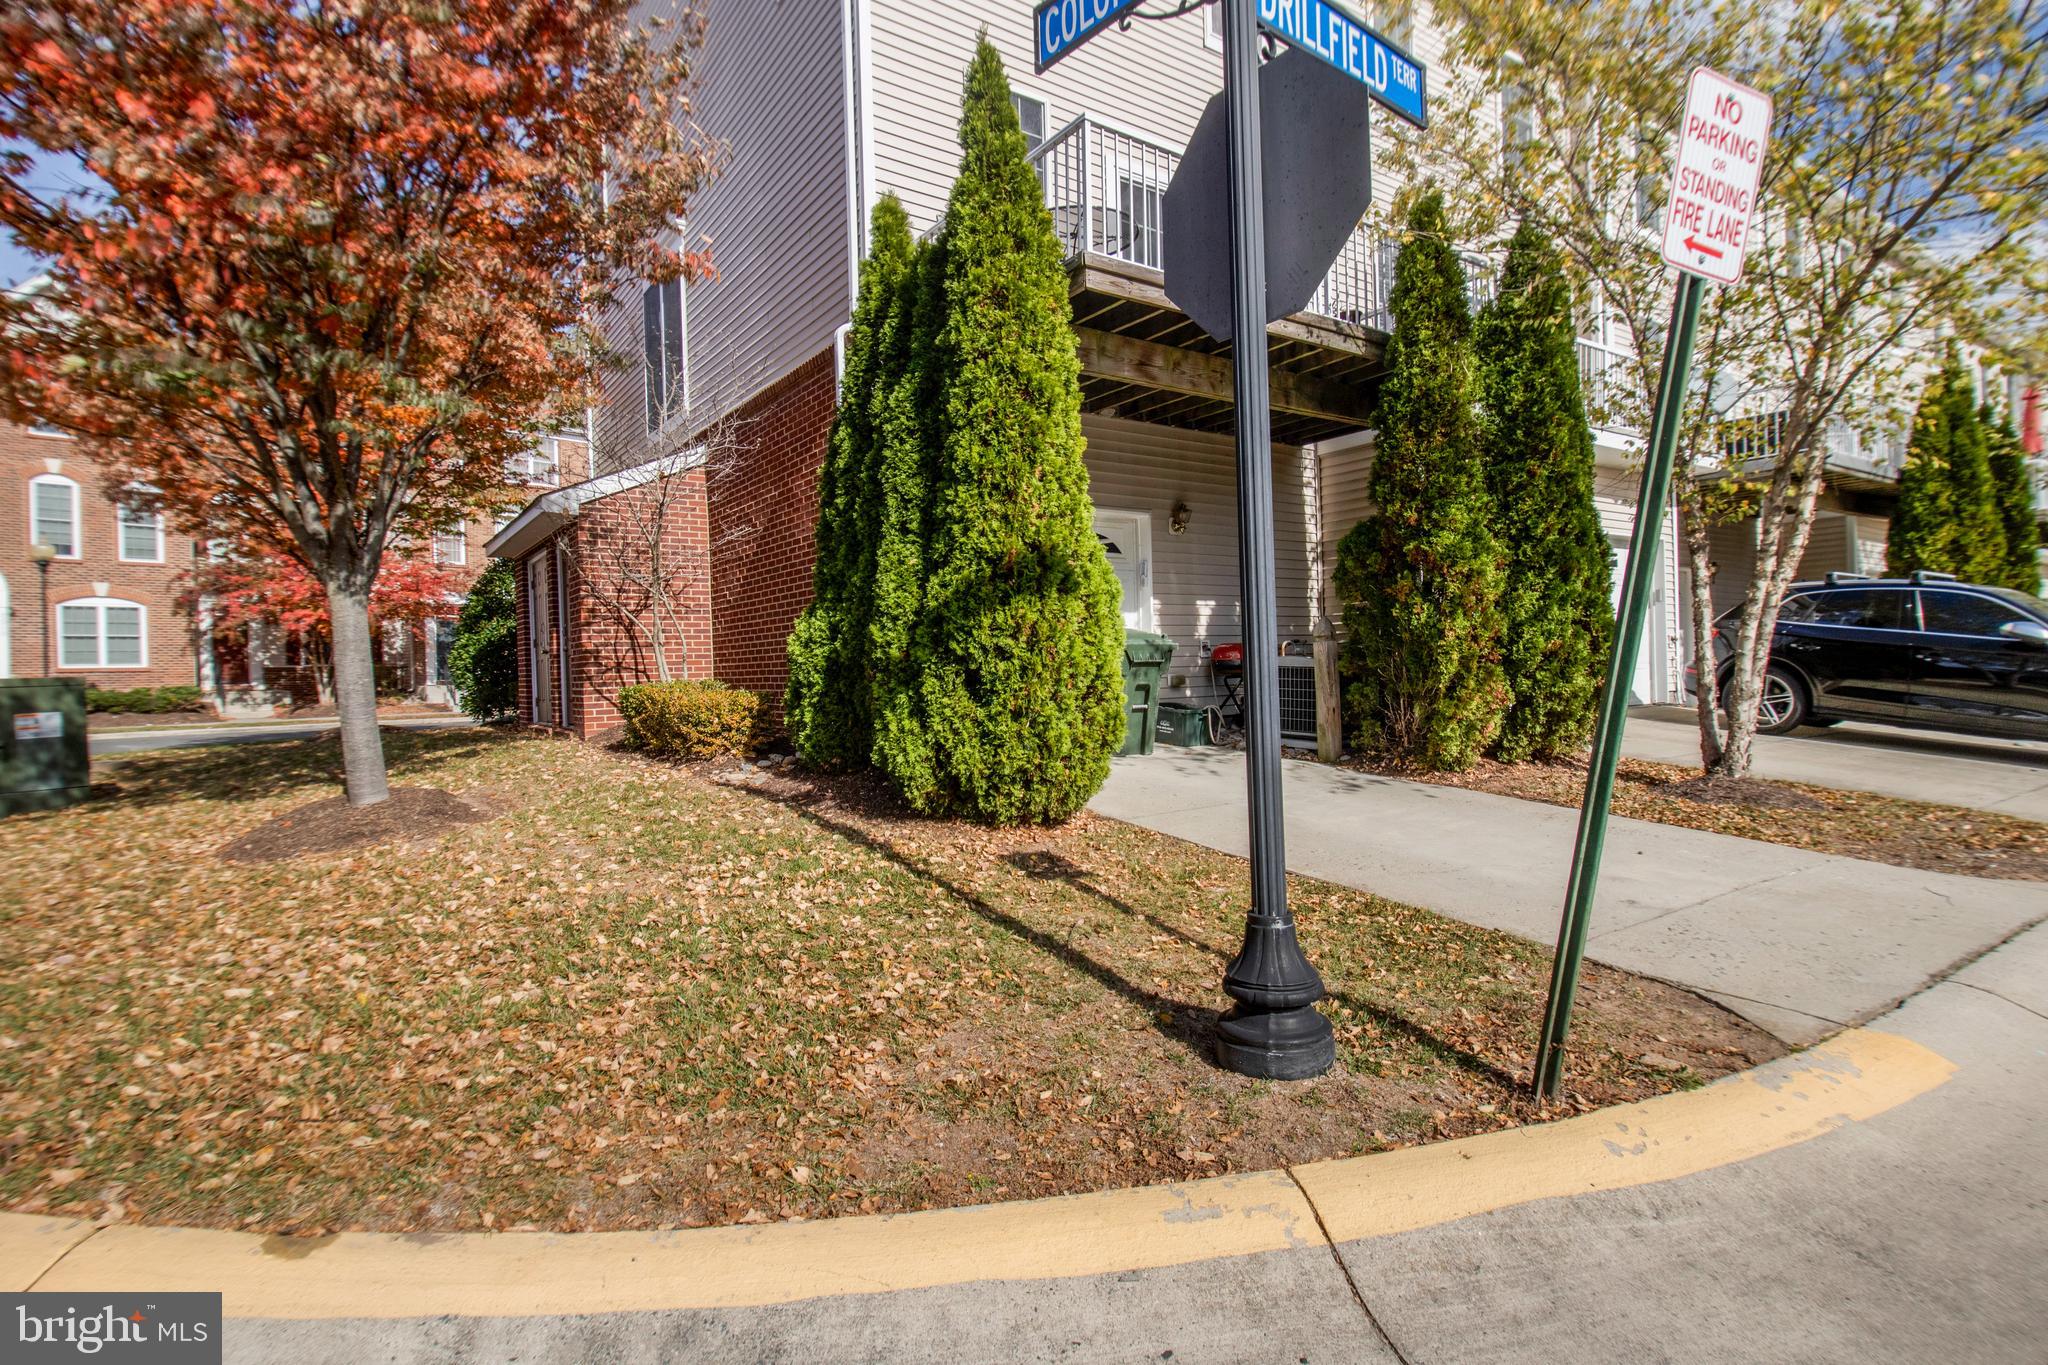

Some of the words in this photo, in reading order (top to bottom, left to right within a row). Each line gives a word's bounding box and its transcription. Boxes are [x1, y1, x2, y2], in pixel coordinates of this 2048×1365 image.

[1046, 0, 1119, 53] COL
[1391, 54, 1416, 94] TERR
[1714, 93, 1742, 125] NO
[1688, 115, 1759, 164] PARKING
[1712, 157, 1727, 171] OR
[1679, 166, 1749, 213] STANDING
[1672, 197, 1704, 233] FIRE
[1706, 209, 1744, 247] LANE
